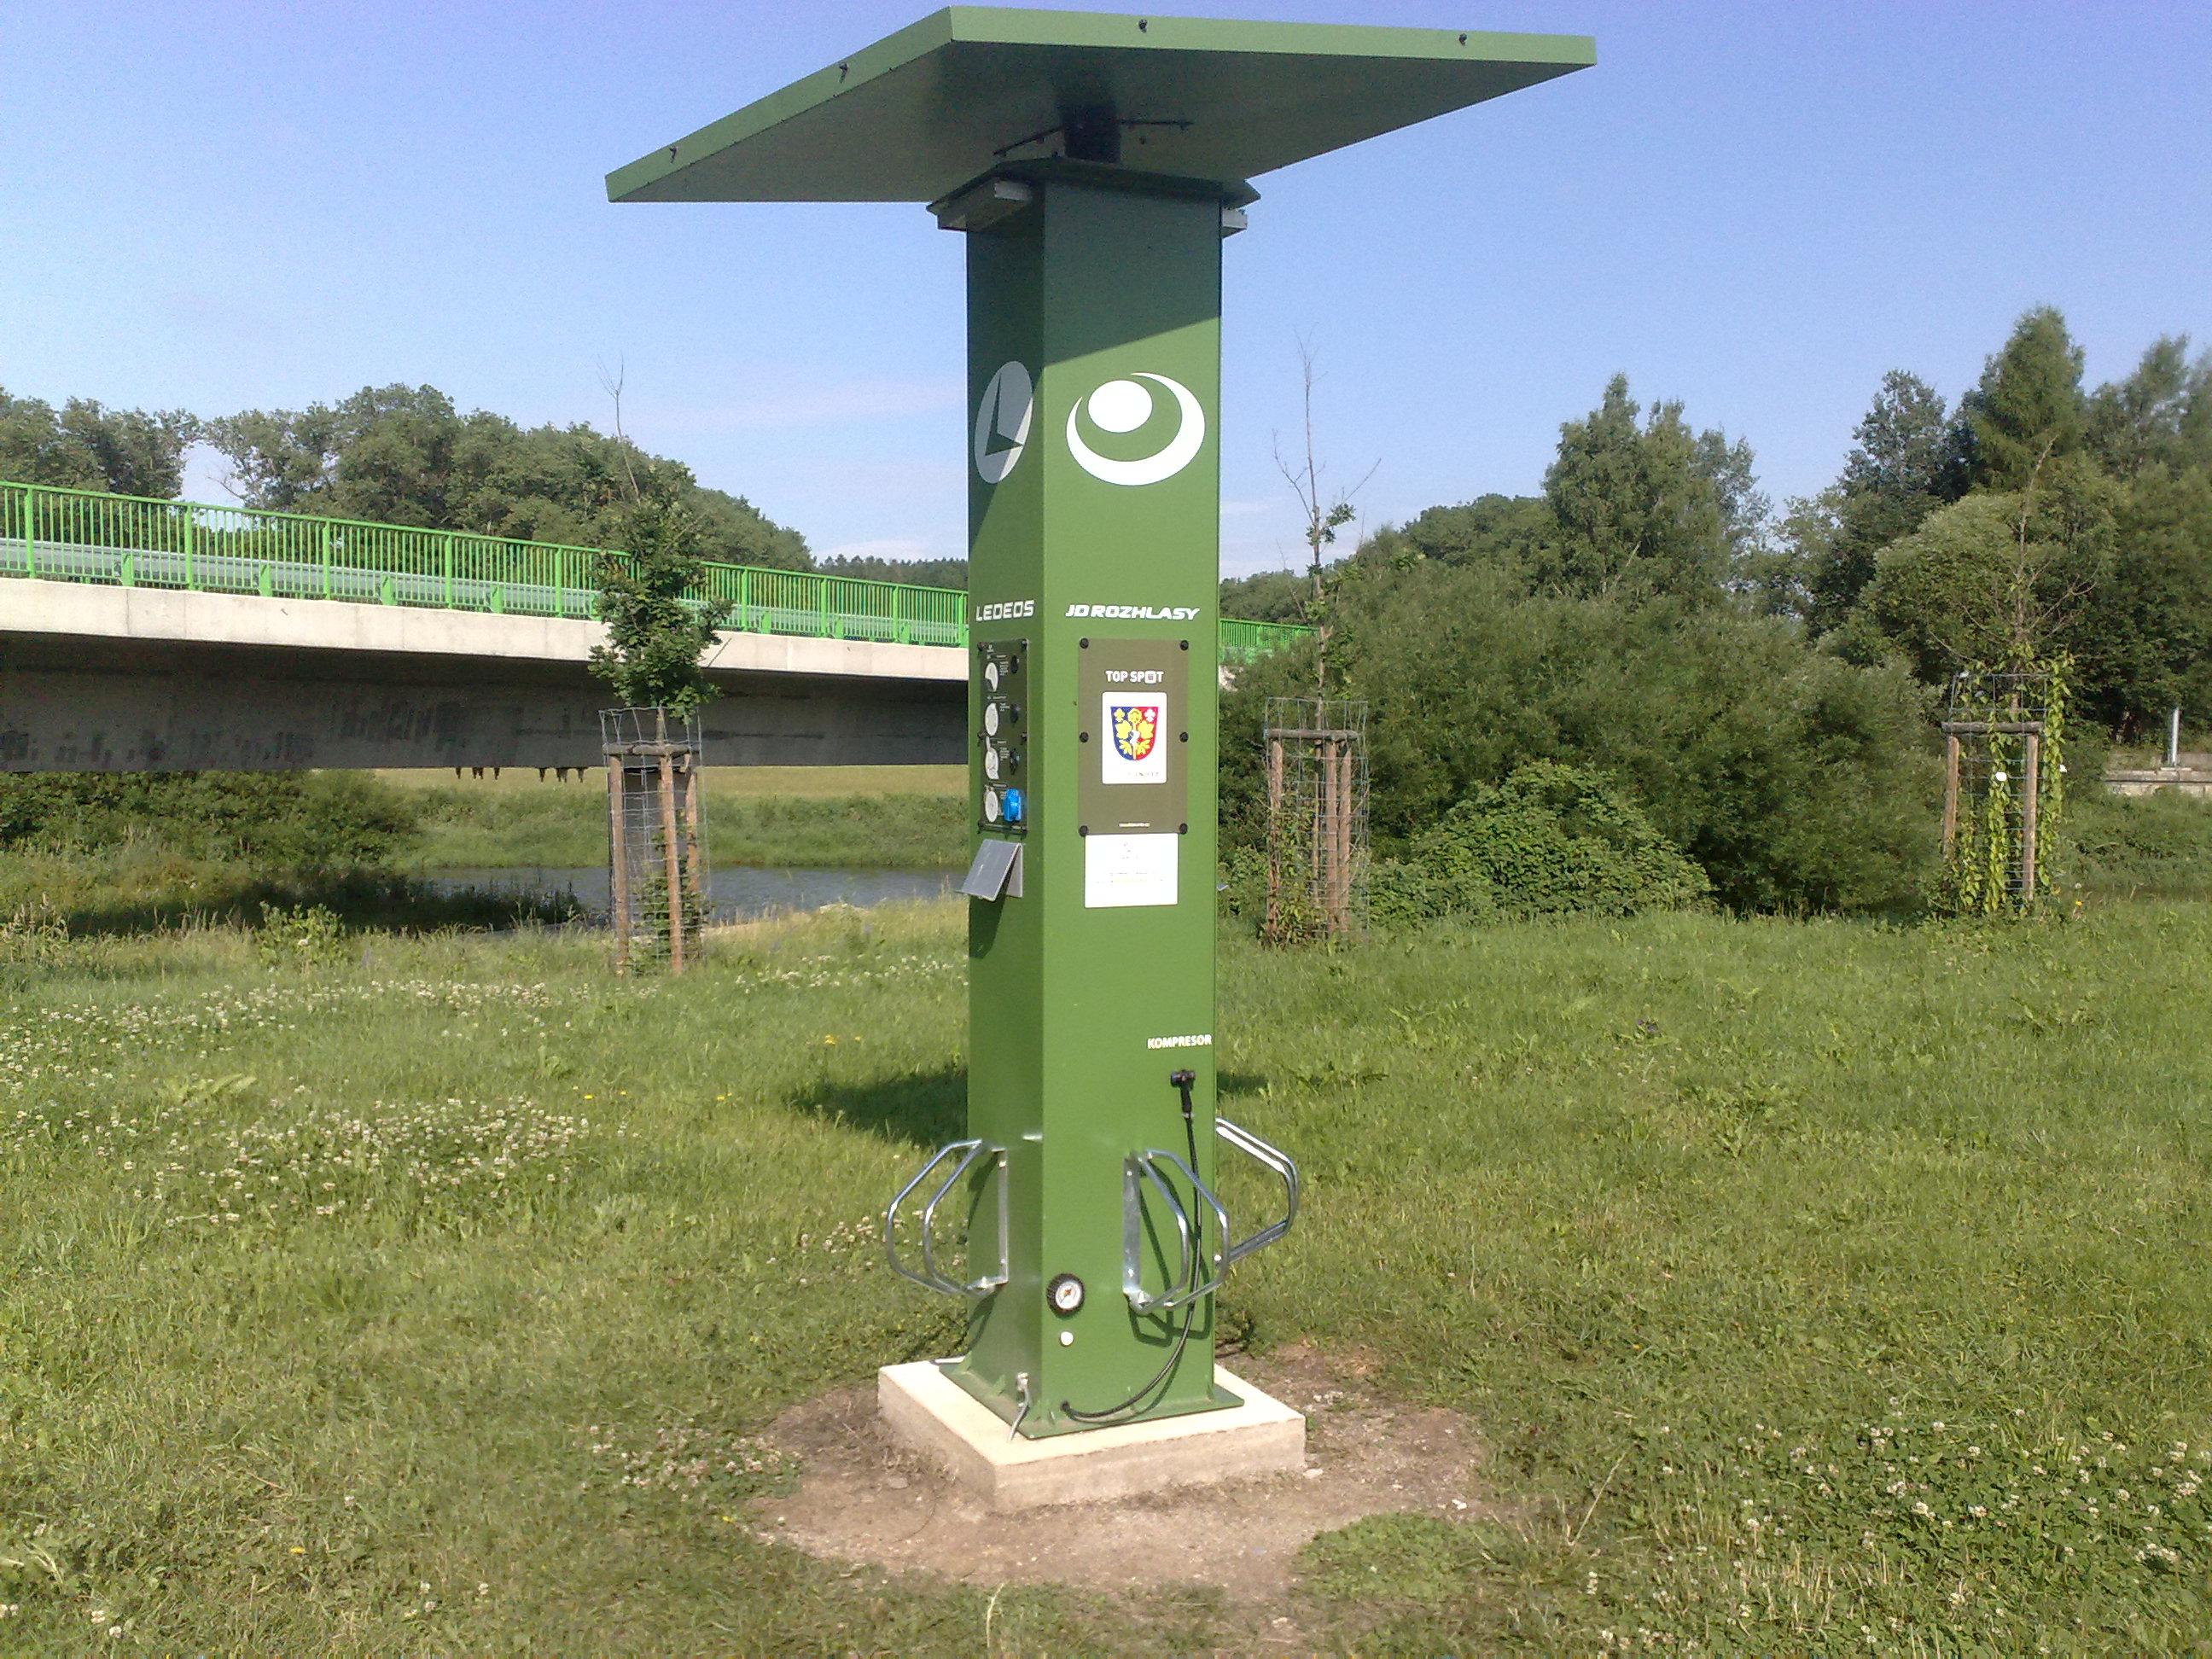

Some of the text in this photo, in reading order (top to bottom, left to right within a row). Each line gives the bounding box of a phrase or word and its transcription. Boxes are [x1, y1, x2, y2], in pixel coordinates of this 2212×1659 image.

[975, 599, 1034, 621] LEDEOS
[1065, 604, 1200, 620] JD ROZHLASY
[1105, 670, 1164, 684] TOP SPOT
[1147, 1034, 1212, 1049] KOMPRESOR
